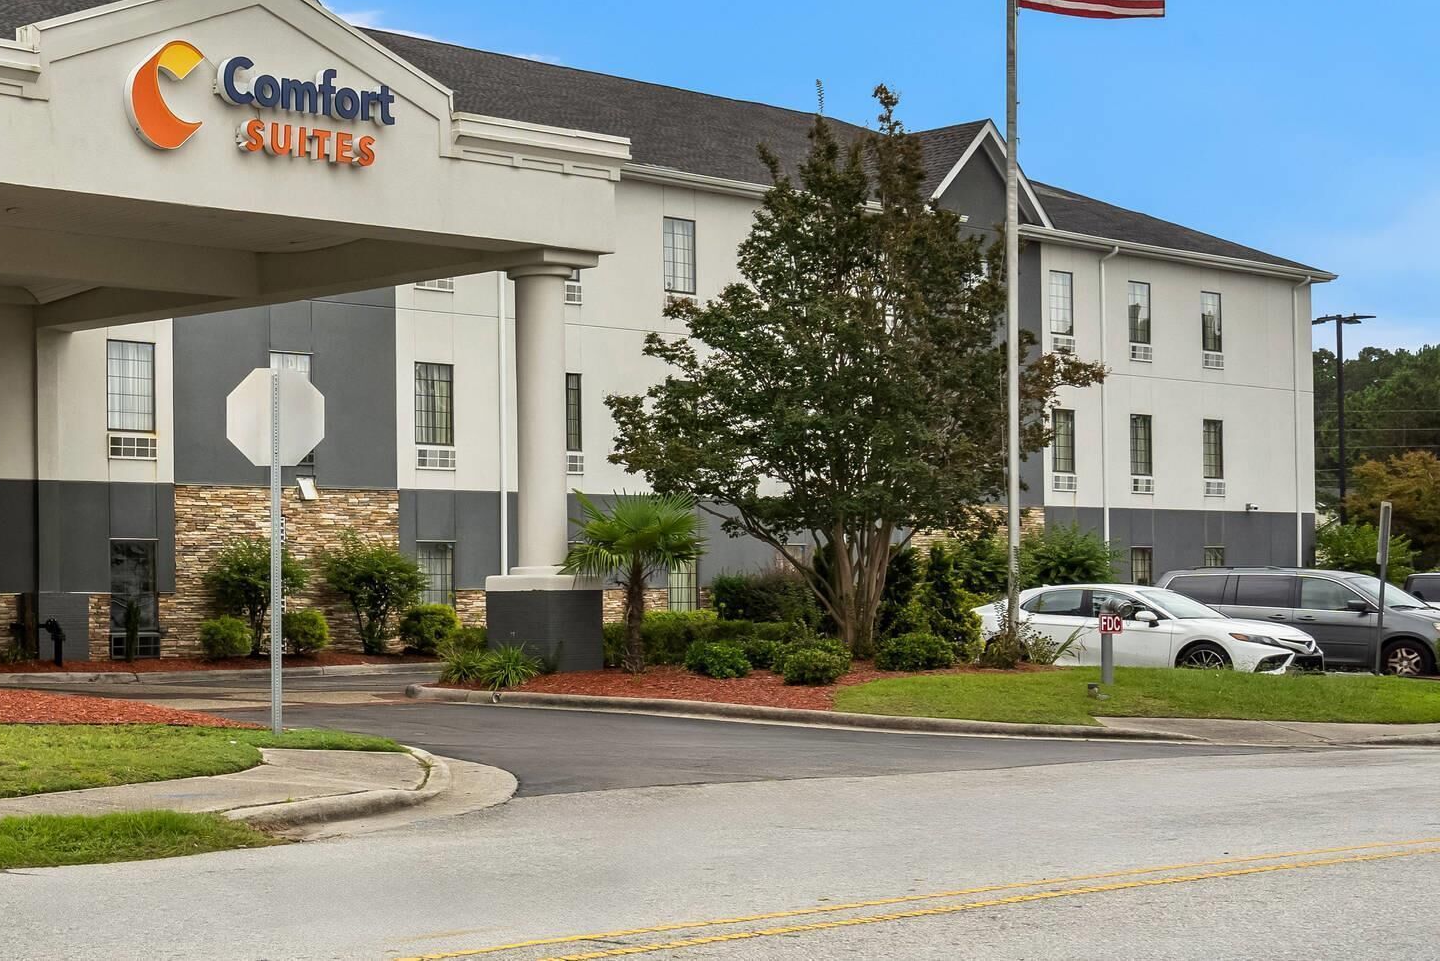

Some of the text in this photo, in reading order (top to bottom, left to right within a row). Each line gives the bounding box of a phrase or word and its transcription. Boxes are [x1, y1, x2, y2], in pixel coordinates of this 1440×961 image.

[220, 55, 395, 126] Comfort
[243, 118, 376, 167] SUITES
[1101, 616, 1121, 631] FDC
